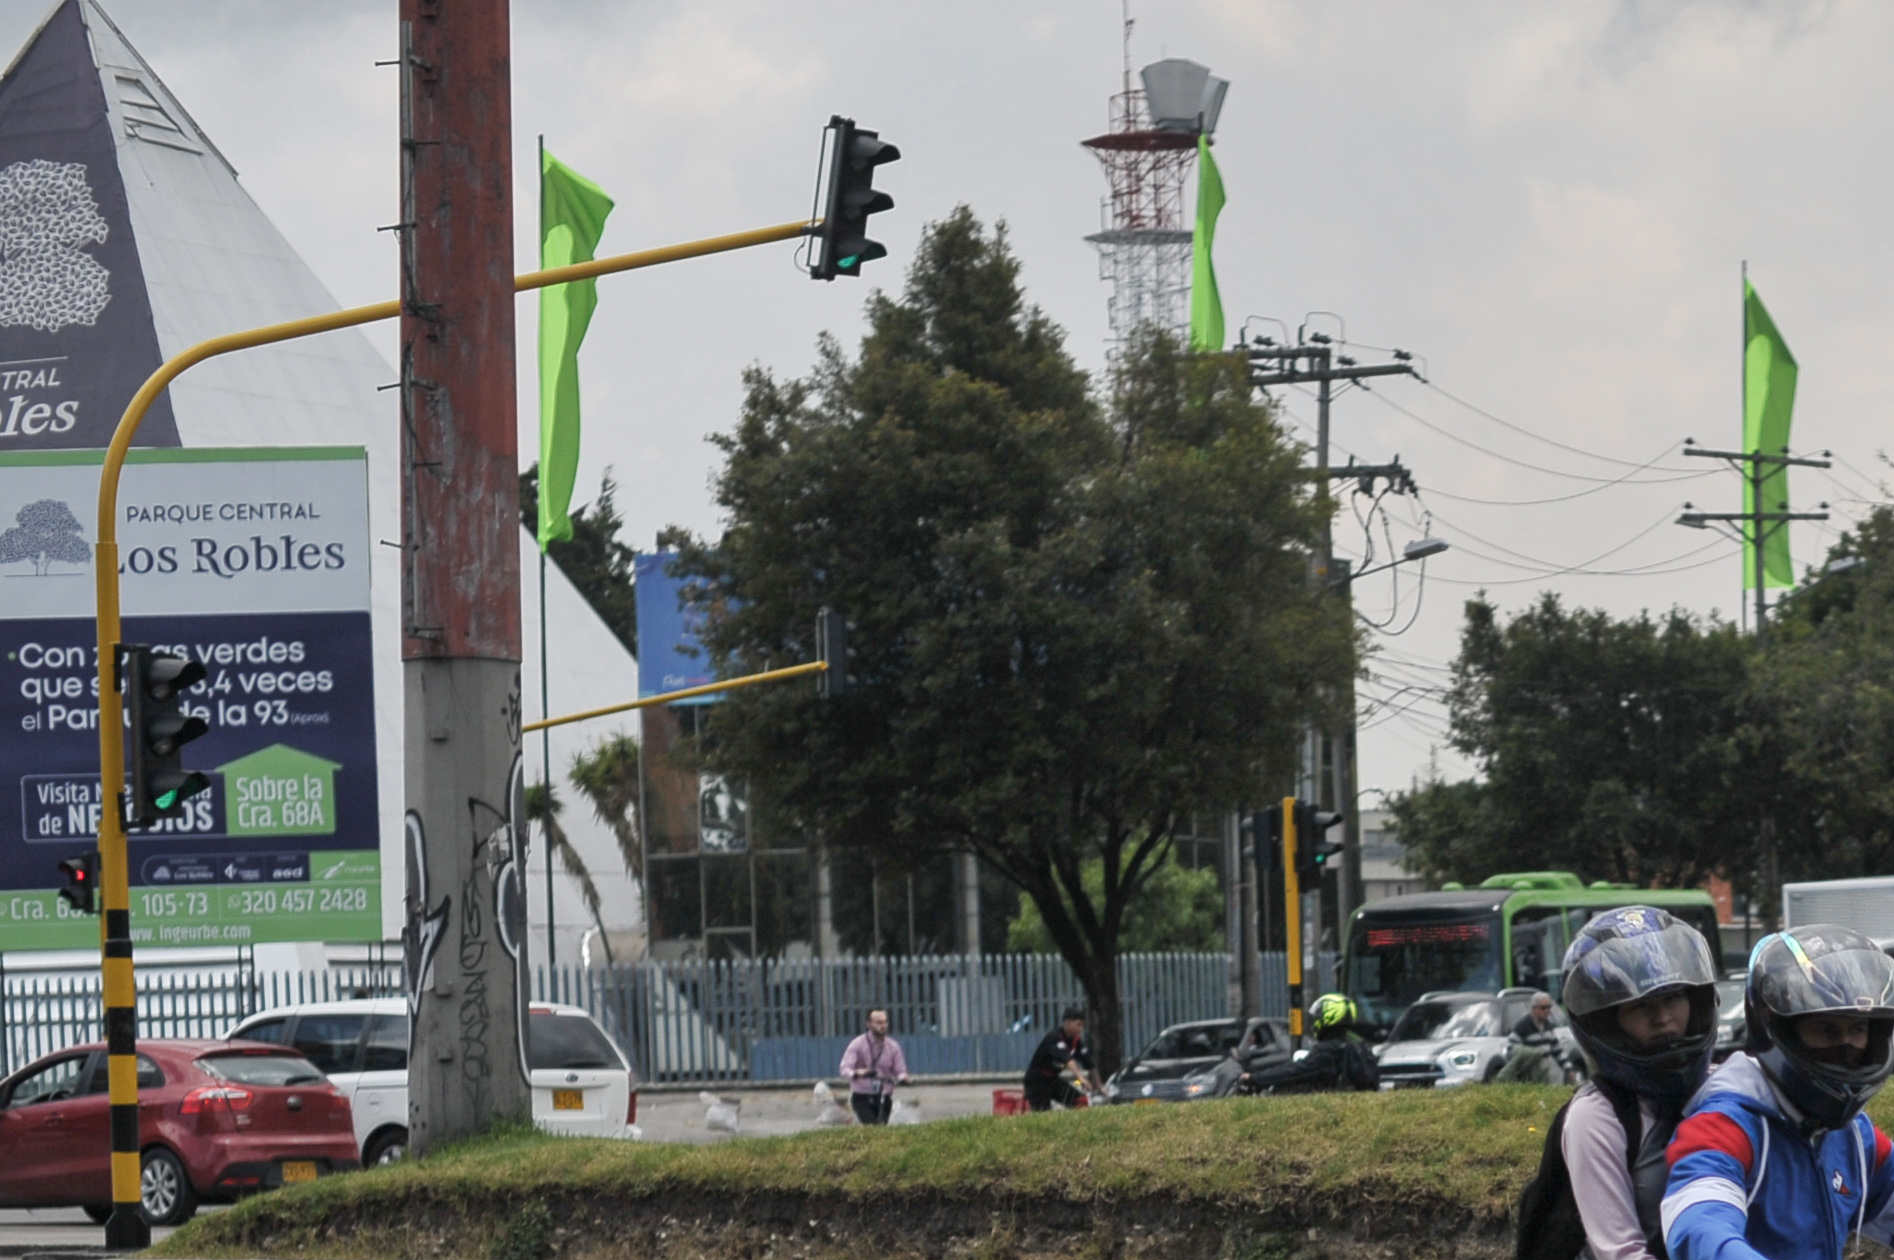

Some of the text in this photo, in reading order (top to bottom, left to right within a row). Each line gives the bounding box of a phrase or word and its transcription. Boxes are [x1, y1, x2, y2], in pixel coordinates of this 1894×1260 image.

[0, 394, 79, 436] les
[126, 502, 320, 524] PARQUE CENTRAL
[191, 534, 346, 579] Robles
[19, 642, 86, 668] Con
[195, 636, 306, 664] verdes
[20, 676, 83, 705] que
[238, 670, 333, 694] veces
[21, 711, 41, 731] el
[218, 699, 247, 726] la
[253, 700, 289, 725] 93
[37, 781, 90, 804] Visita
[236, 776, 299, 802] Sobre
[304, 775, 323, 801] la
[39, 813, 62, 835] de
[238, 802, 325, 829] Cra. 68A
[11, 897, 49, 920] Cra.
[241, 887, 368, 914] 320 457 2428
